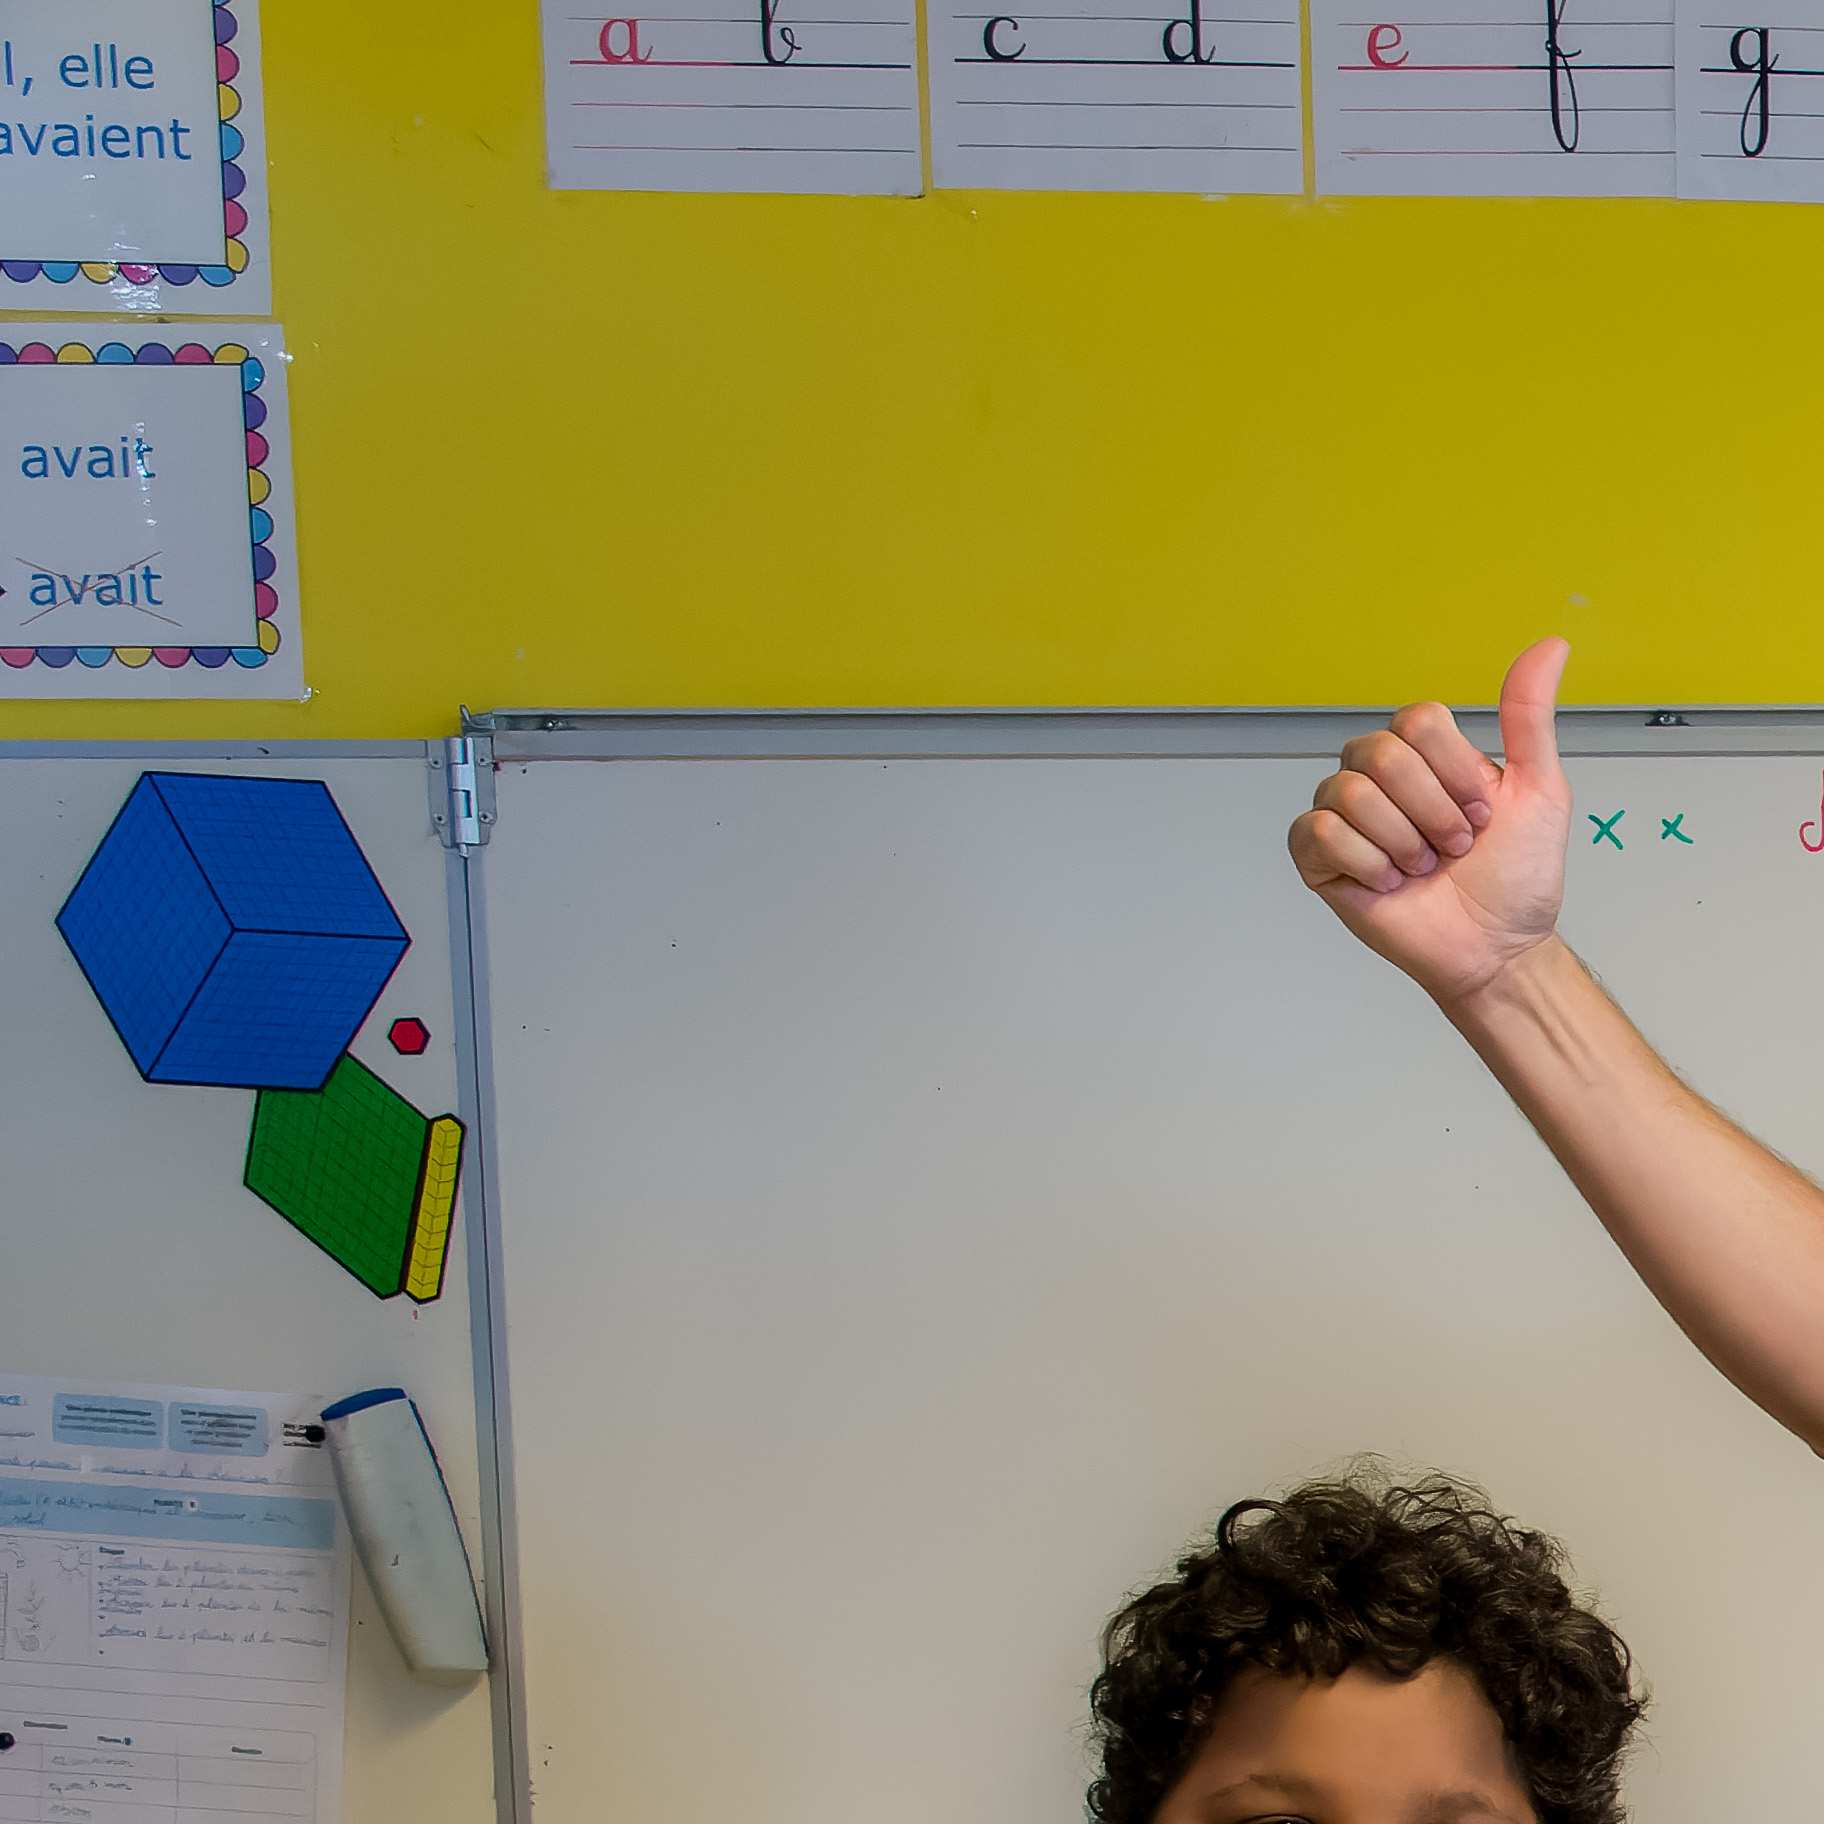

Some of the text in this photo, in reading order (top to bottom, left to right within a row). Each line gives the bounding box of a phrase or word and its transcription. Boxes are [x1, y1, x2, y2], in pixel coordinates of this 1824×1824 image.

[601, 19, 652, 64] a
[983, 15, 1025, 61] c
[1369, 23, 1409, 68] e
[59, 43, 154, 89] elle
[1730, 28, 1778, 157] g
[22, 437, 155, 479] avait
[29, 565, 163, 606] avait
